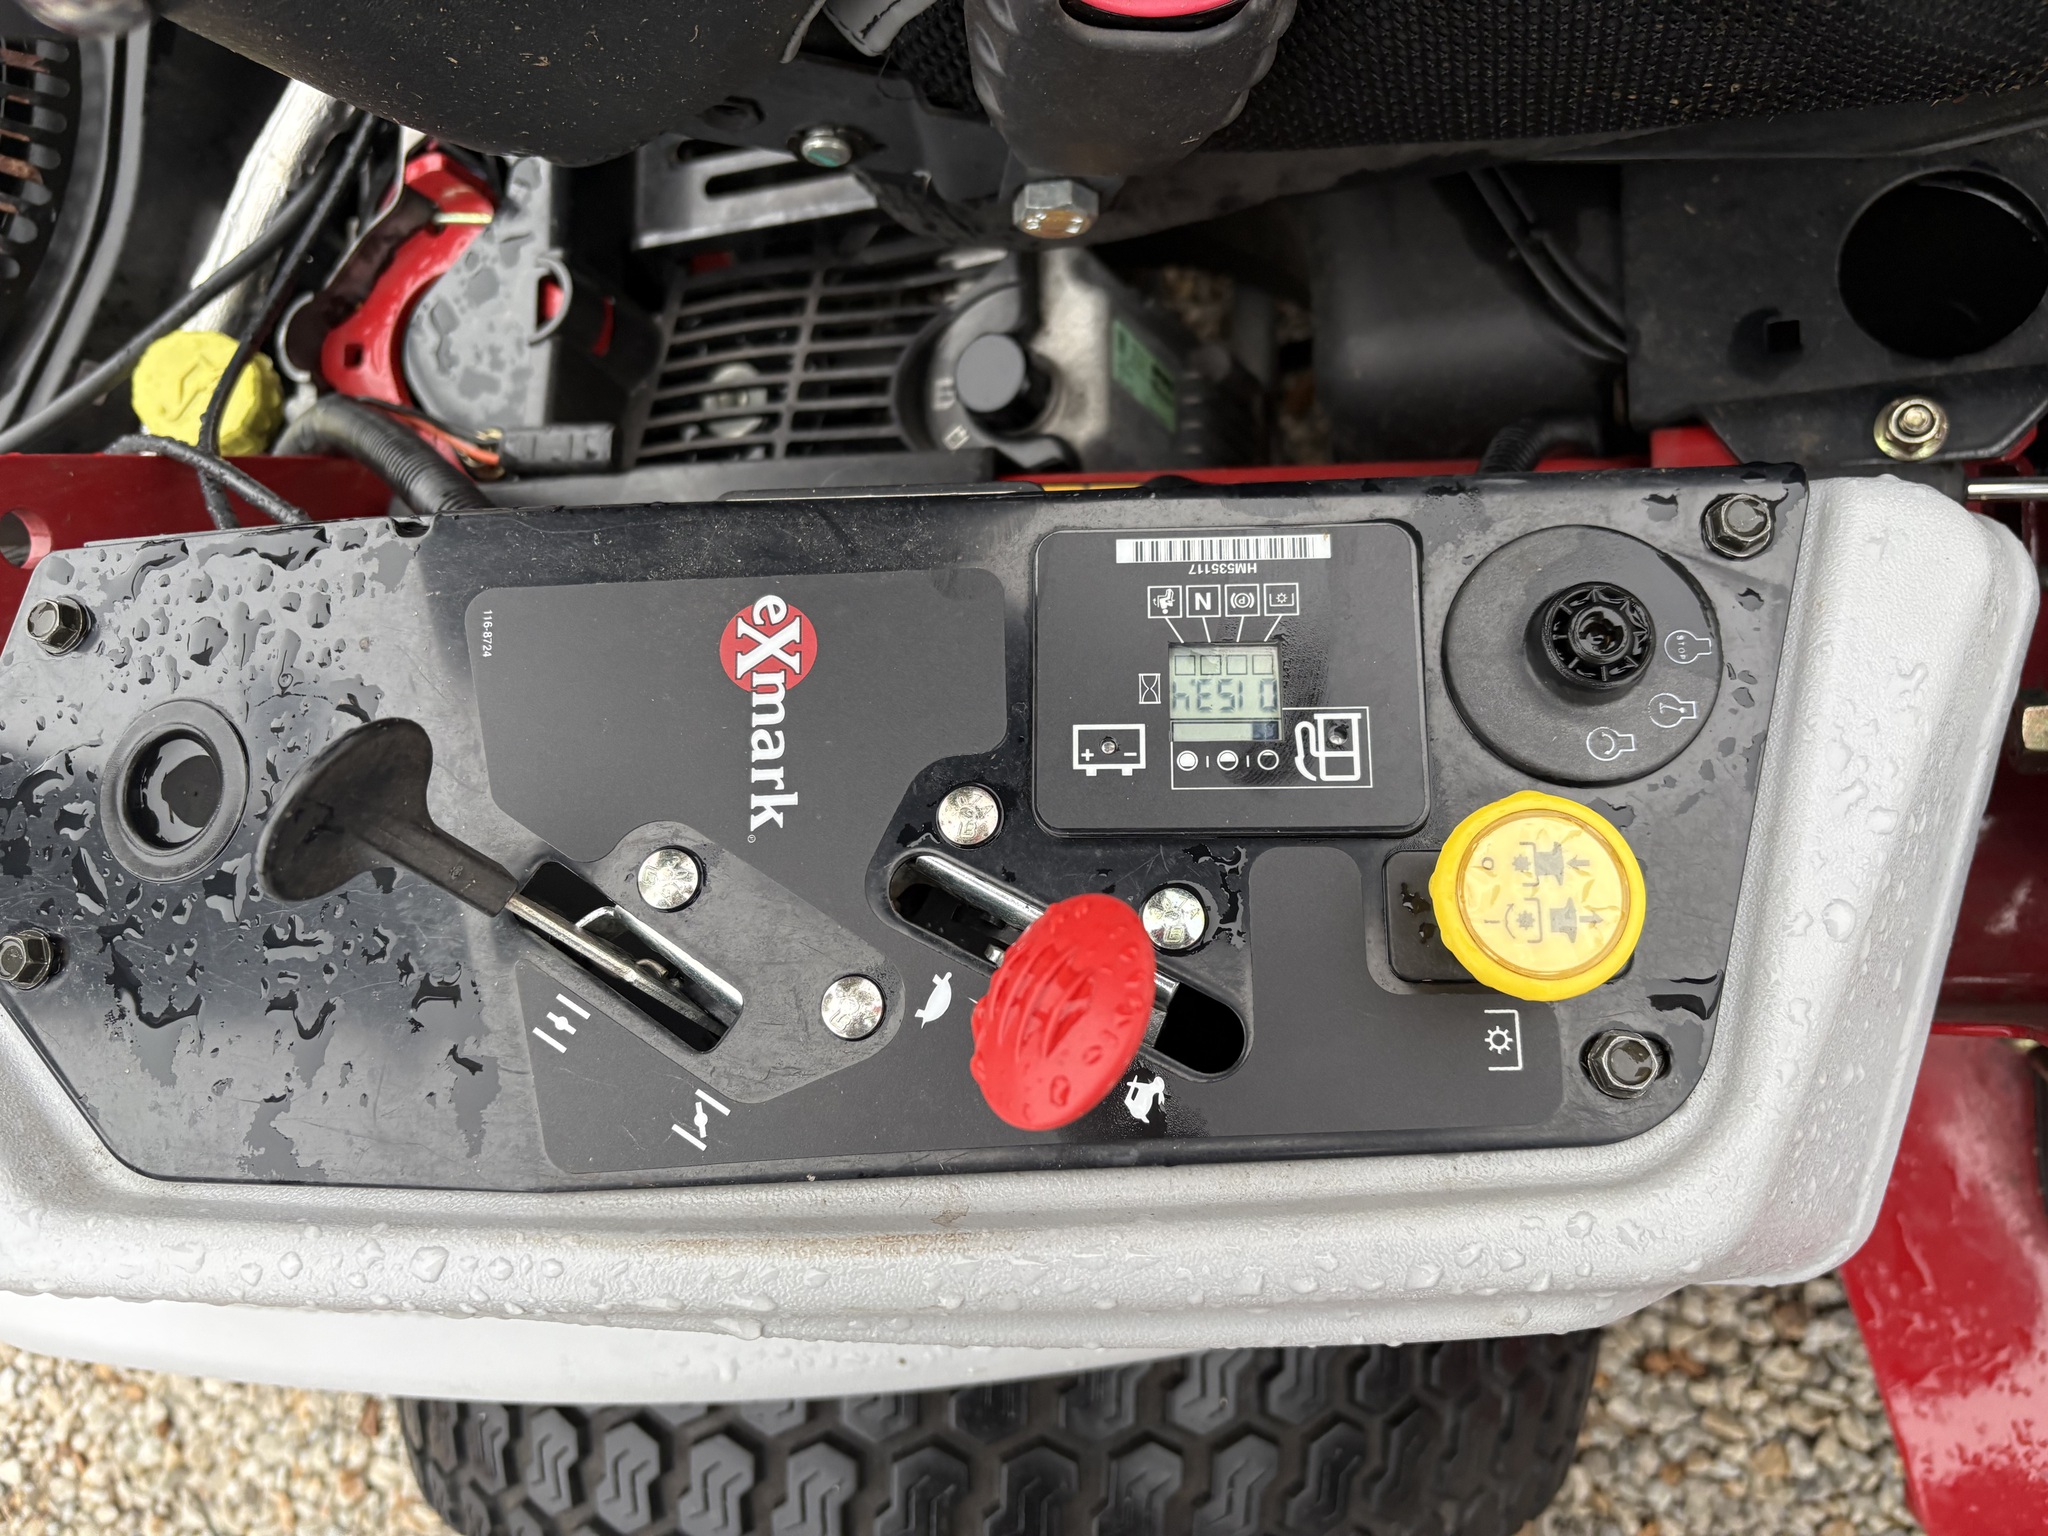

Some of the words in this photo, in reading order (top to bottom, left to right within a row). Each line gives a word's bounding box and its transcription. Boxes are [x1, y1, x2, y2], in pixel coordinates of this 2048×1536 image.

[1188, 563, 1257, 575] HM535117
[1194, 592, 1212, 611] N
[482, 610, 493, 657] 116-8724
[1676, 635, 1687, 660] STOP
[735, 594, 801, 831] eXmark
